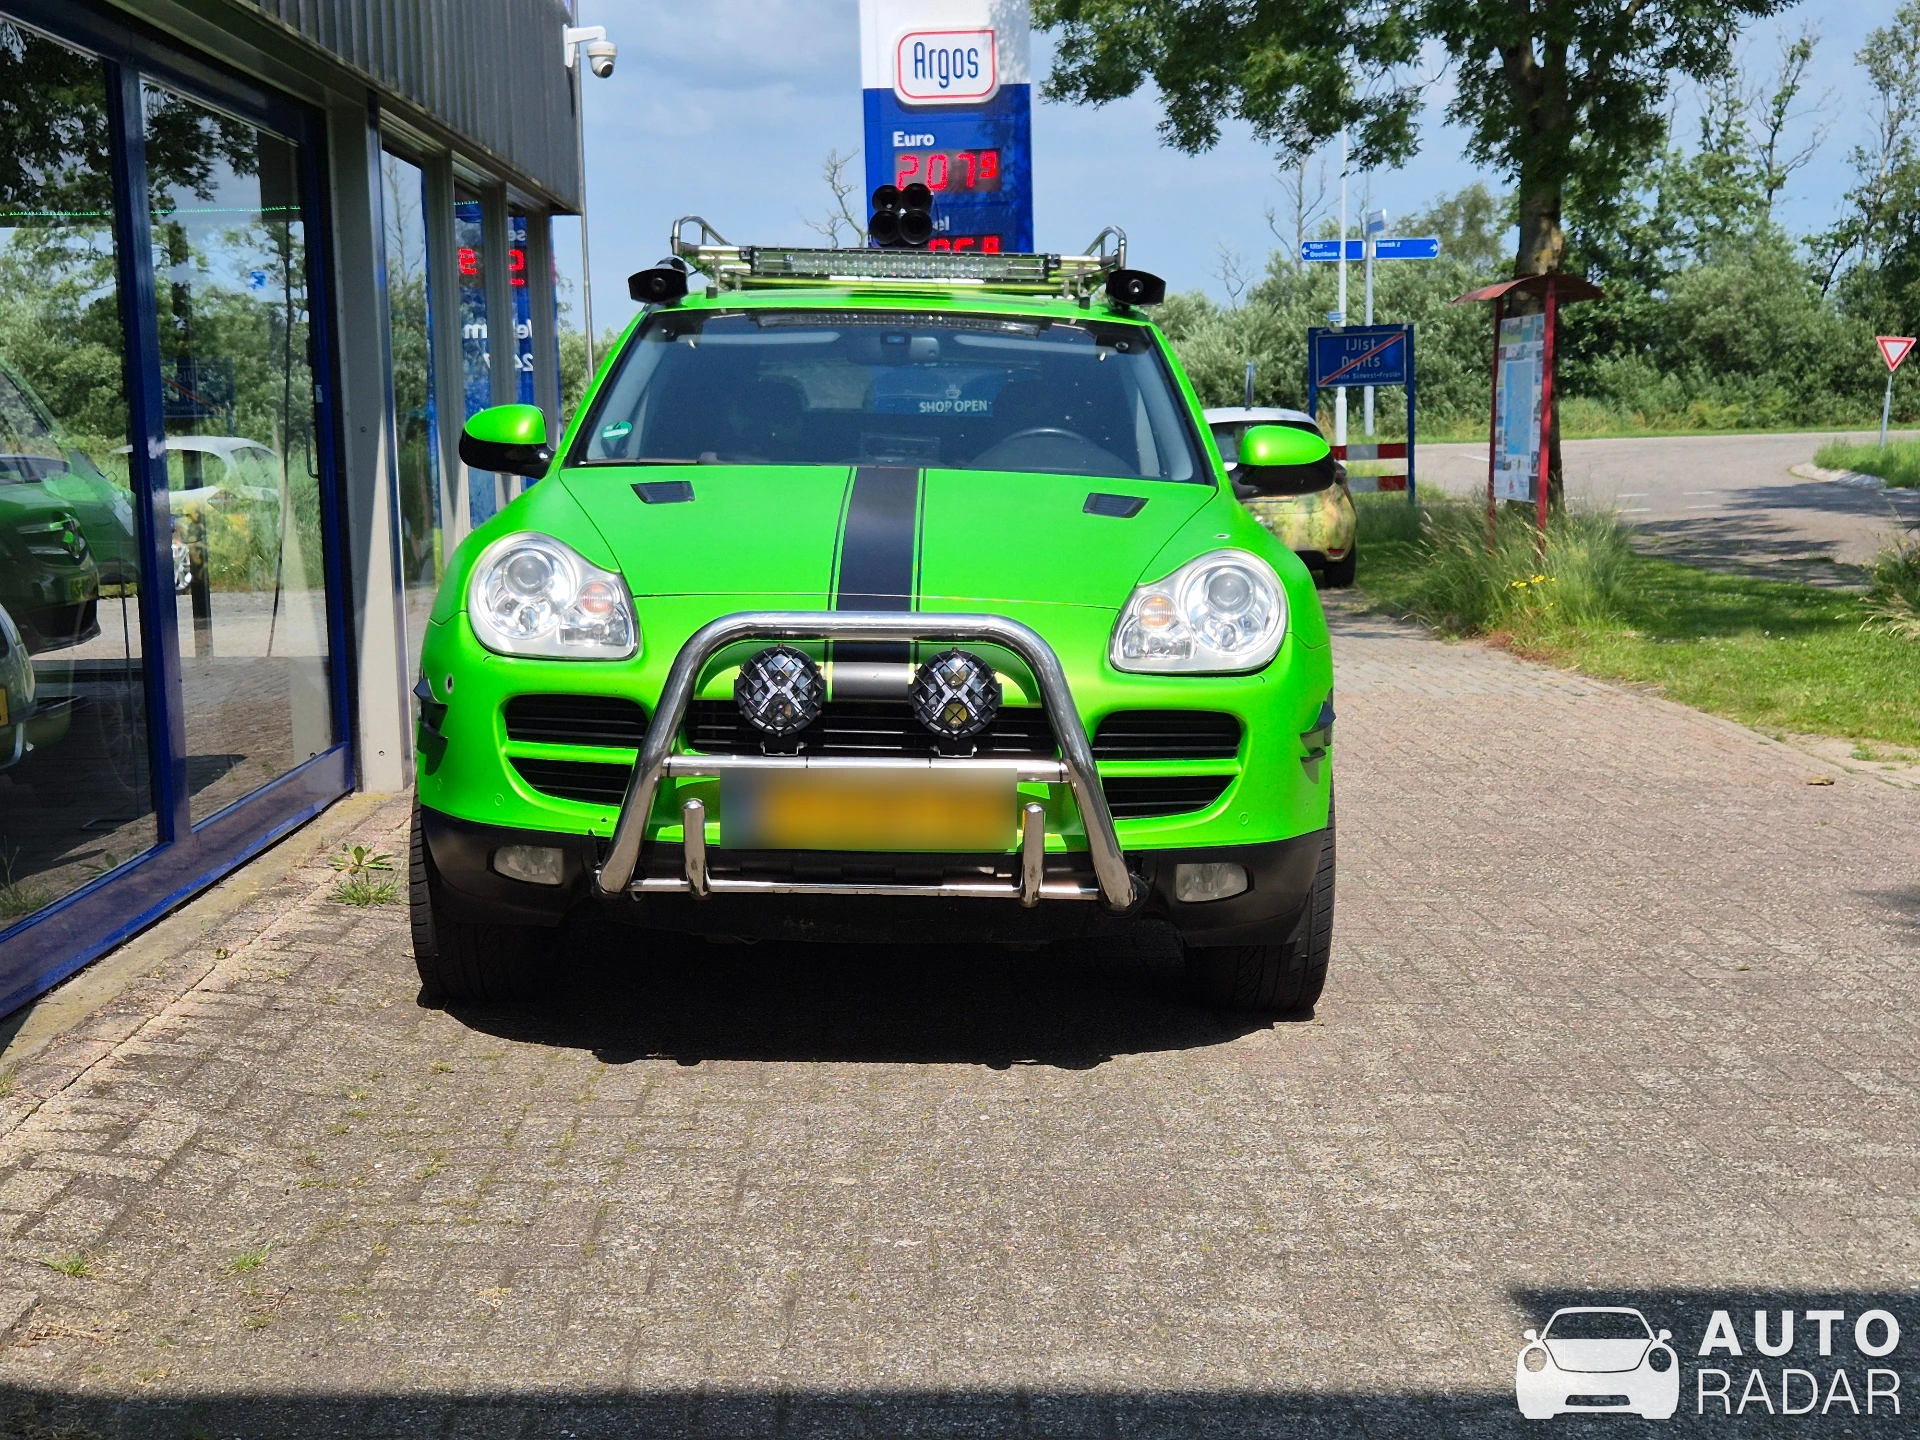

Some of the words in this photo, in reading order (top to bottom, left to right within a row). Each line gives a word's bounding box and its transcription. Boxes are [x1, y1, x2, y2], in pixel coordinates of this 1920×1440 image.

[913, 41, 979, 89] Argos
[892, 131, 935, 147] Euro
[919, 401, 952, 414] SHOP
[954, 400, 988, 413] OPEN
